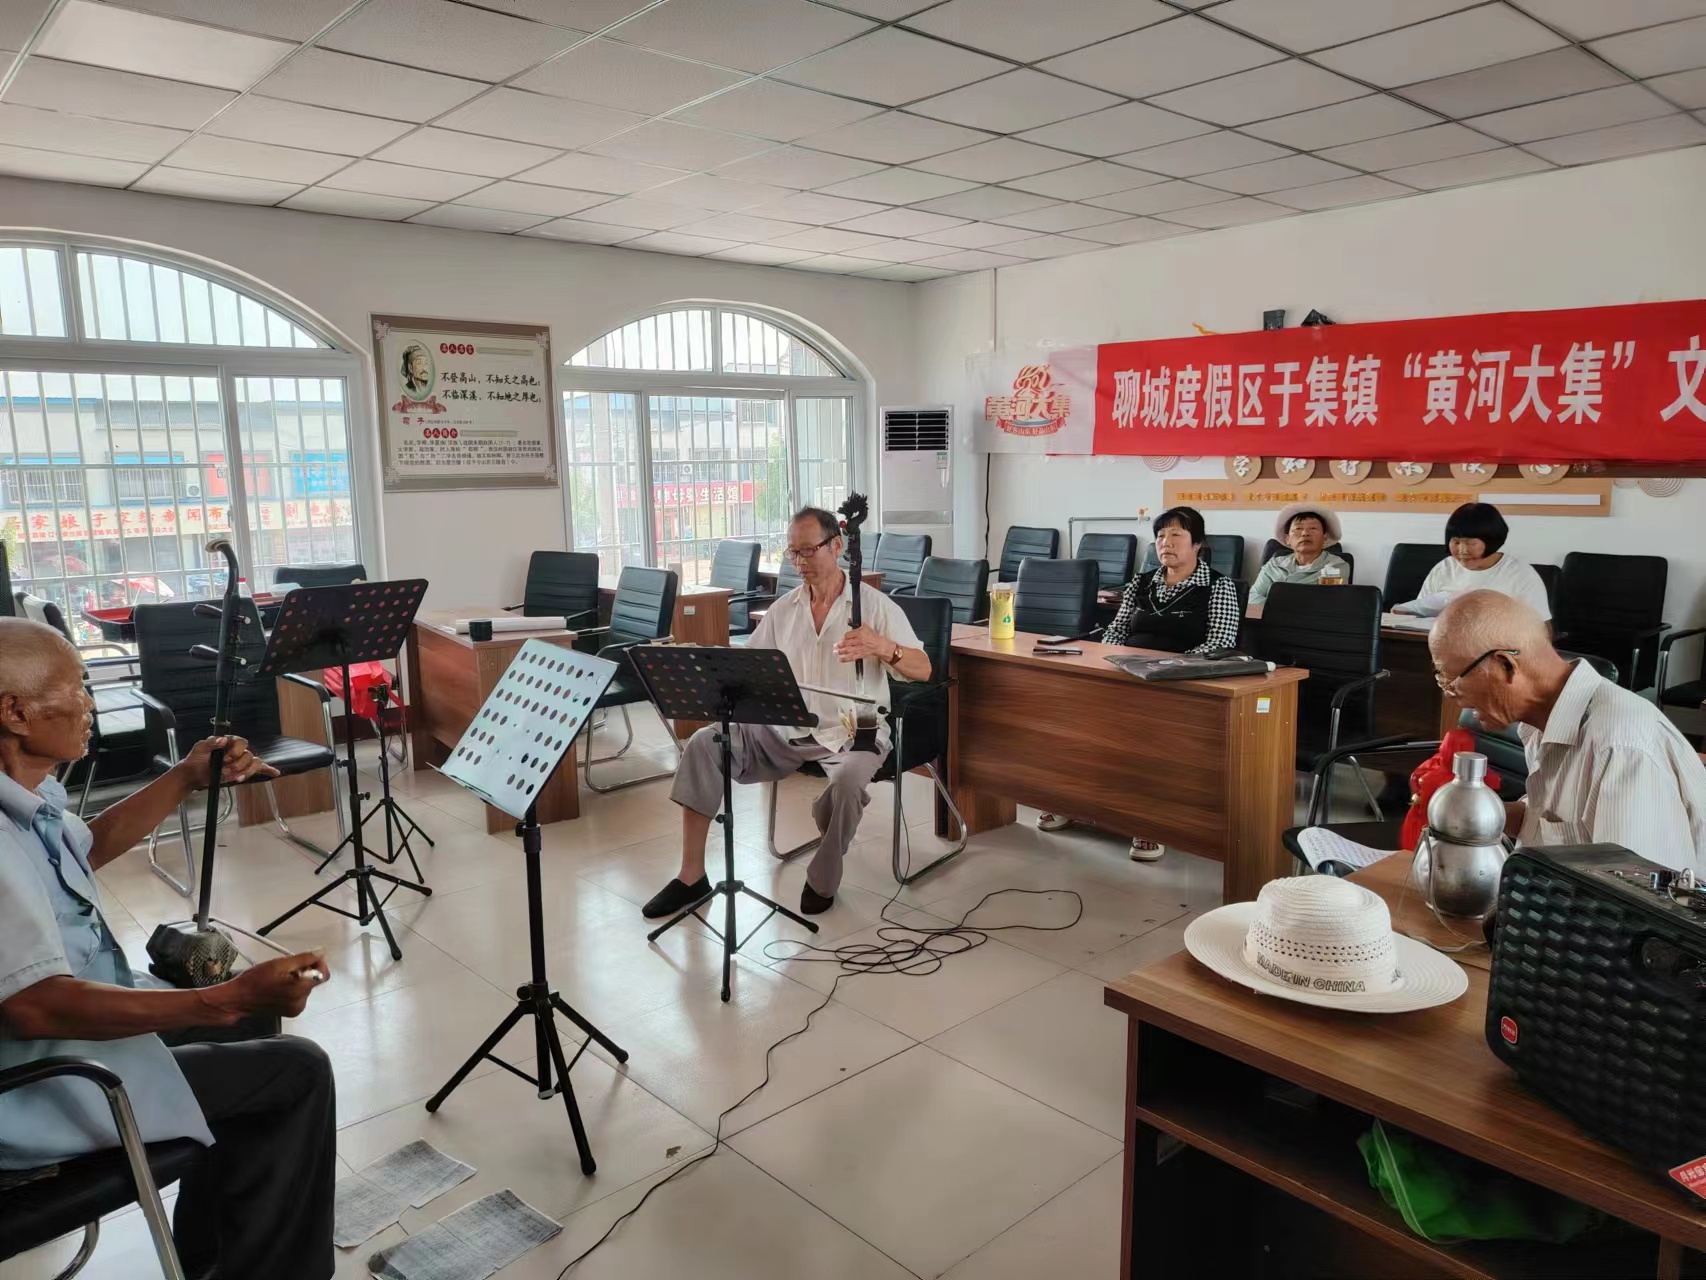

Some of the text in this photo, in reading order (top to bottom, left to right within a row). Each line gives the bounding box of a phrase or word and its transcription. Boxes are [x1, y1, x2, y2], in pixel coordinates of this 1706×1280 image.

[1112, 353, 1381, 429] 聊城度假区于集镇
[1660, 334, 1706, 422] 文
[985, 391, 1071, 421] 黄河大集
[1256, 951, 1366, 993] MADE IN CHINA
